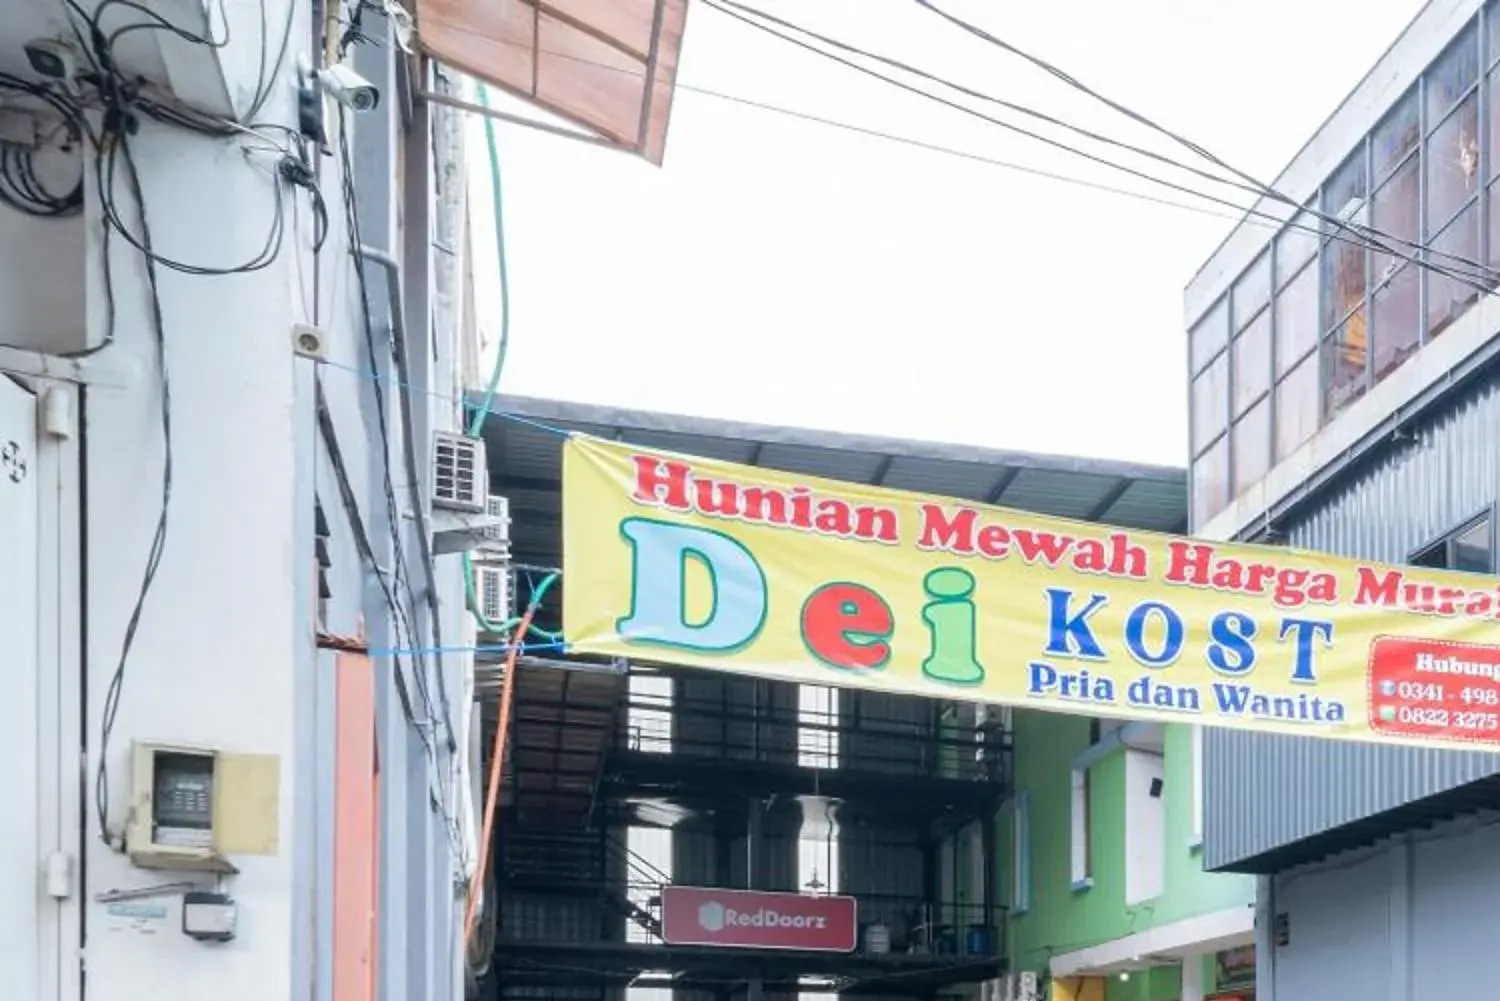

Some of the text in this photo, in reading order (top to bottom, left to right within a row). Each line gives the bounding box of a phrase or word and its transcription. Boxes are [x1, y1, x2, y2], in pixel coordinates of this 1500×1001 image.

[630, 455, 900, 546] Hunian
[917, 503, 1148, 580] Mewah
[1165, 540, 1339, 608] Harga
[615, 516, 986, 686] Dei
[1043, 587, 1334, 684] KOST
[1028, 662, 1347, 724] Pria dan Wanita
[1397, 681, 1444, 702] 0341
[1459, 686, 1498, 706] 498
[1398, 707, 1450, 727] 0822
[1452, 710, 1499, 731] 3275
[725, 908, 829, 930] RedDoorz
